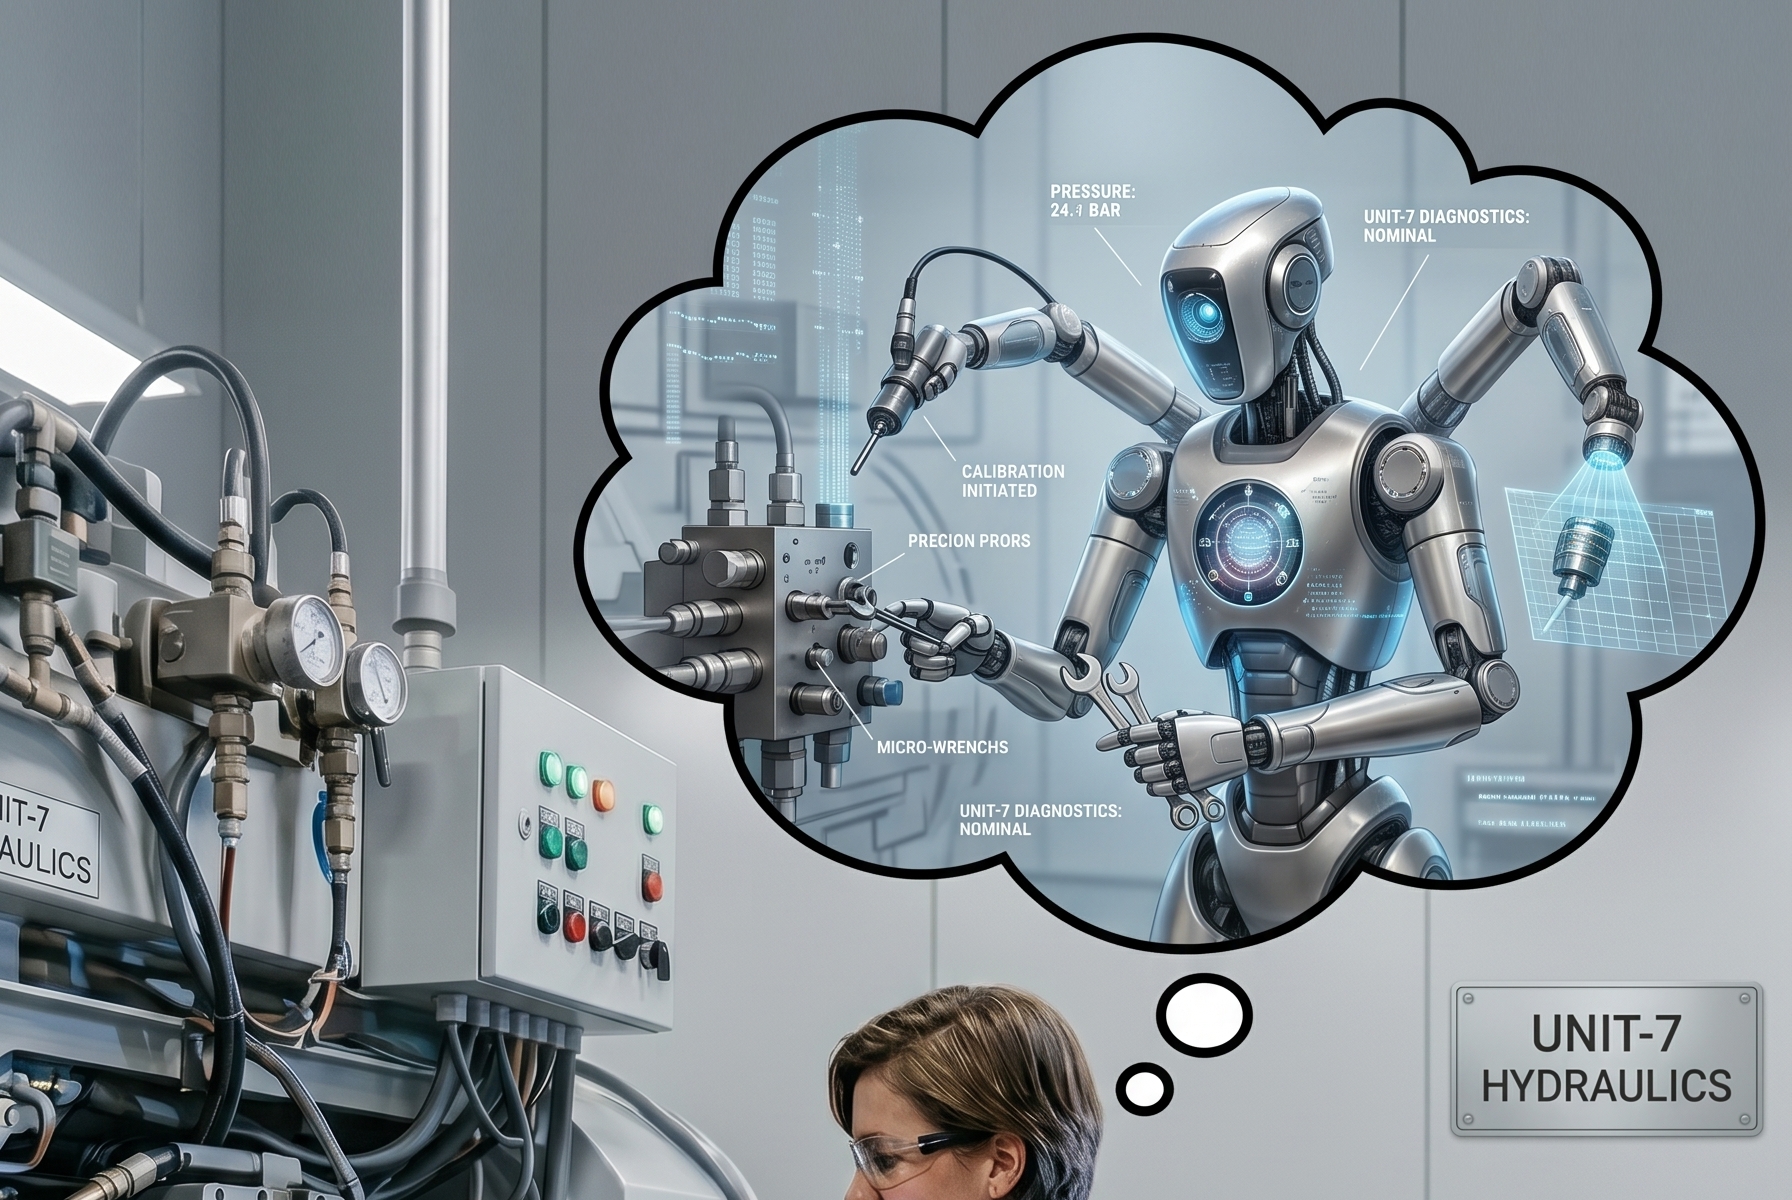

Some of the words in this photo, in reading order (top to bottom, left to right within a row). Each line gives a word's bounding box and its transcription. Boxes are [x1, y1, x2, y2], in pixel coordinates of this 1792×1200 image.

[0, 795, 50, 832] IT-7
[1532, 1013, 1682, 1053] UNIT-7
[1483, 1068, 1732, 1103] HYDRAULICS
